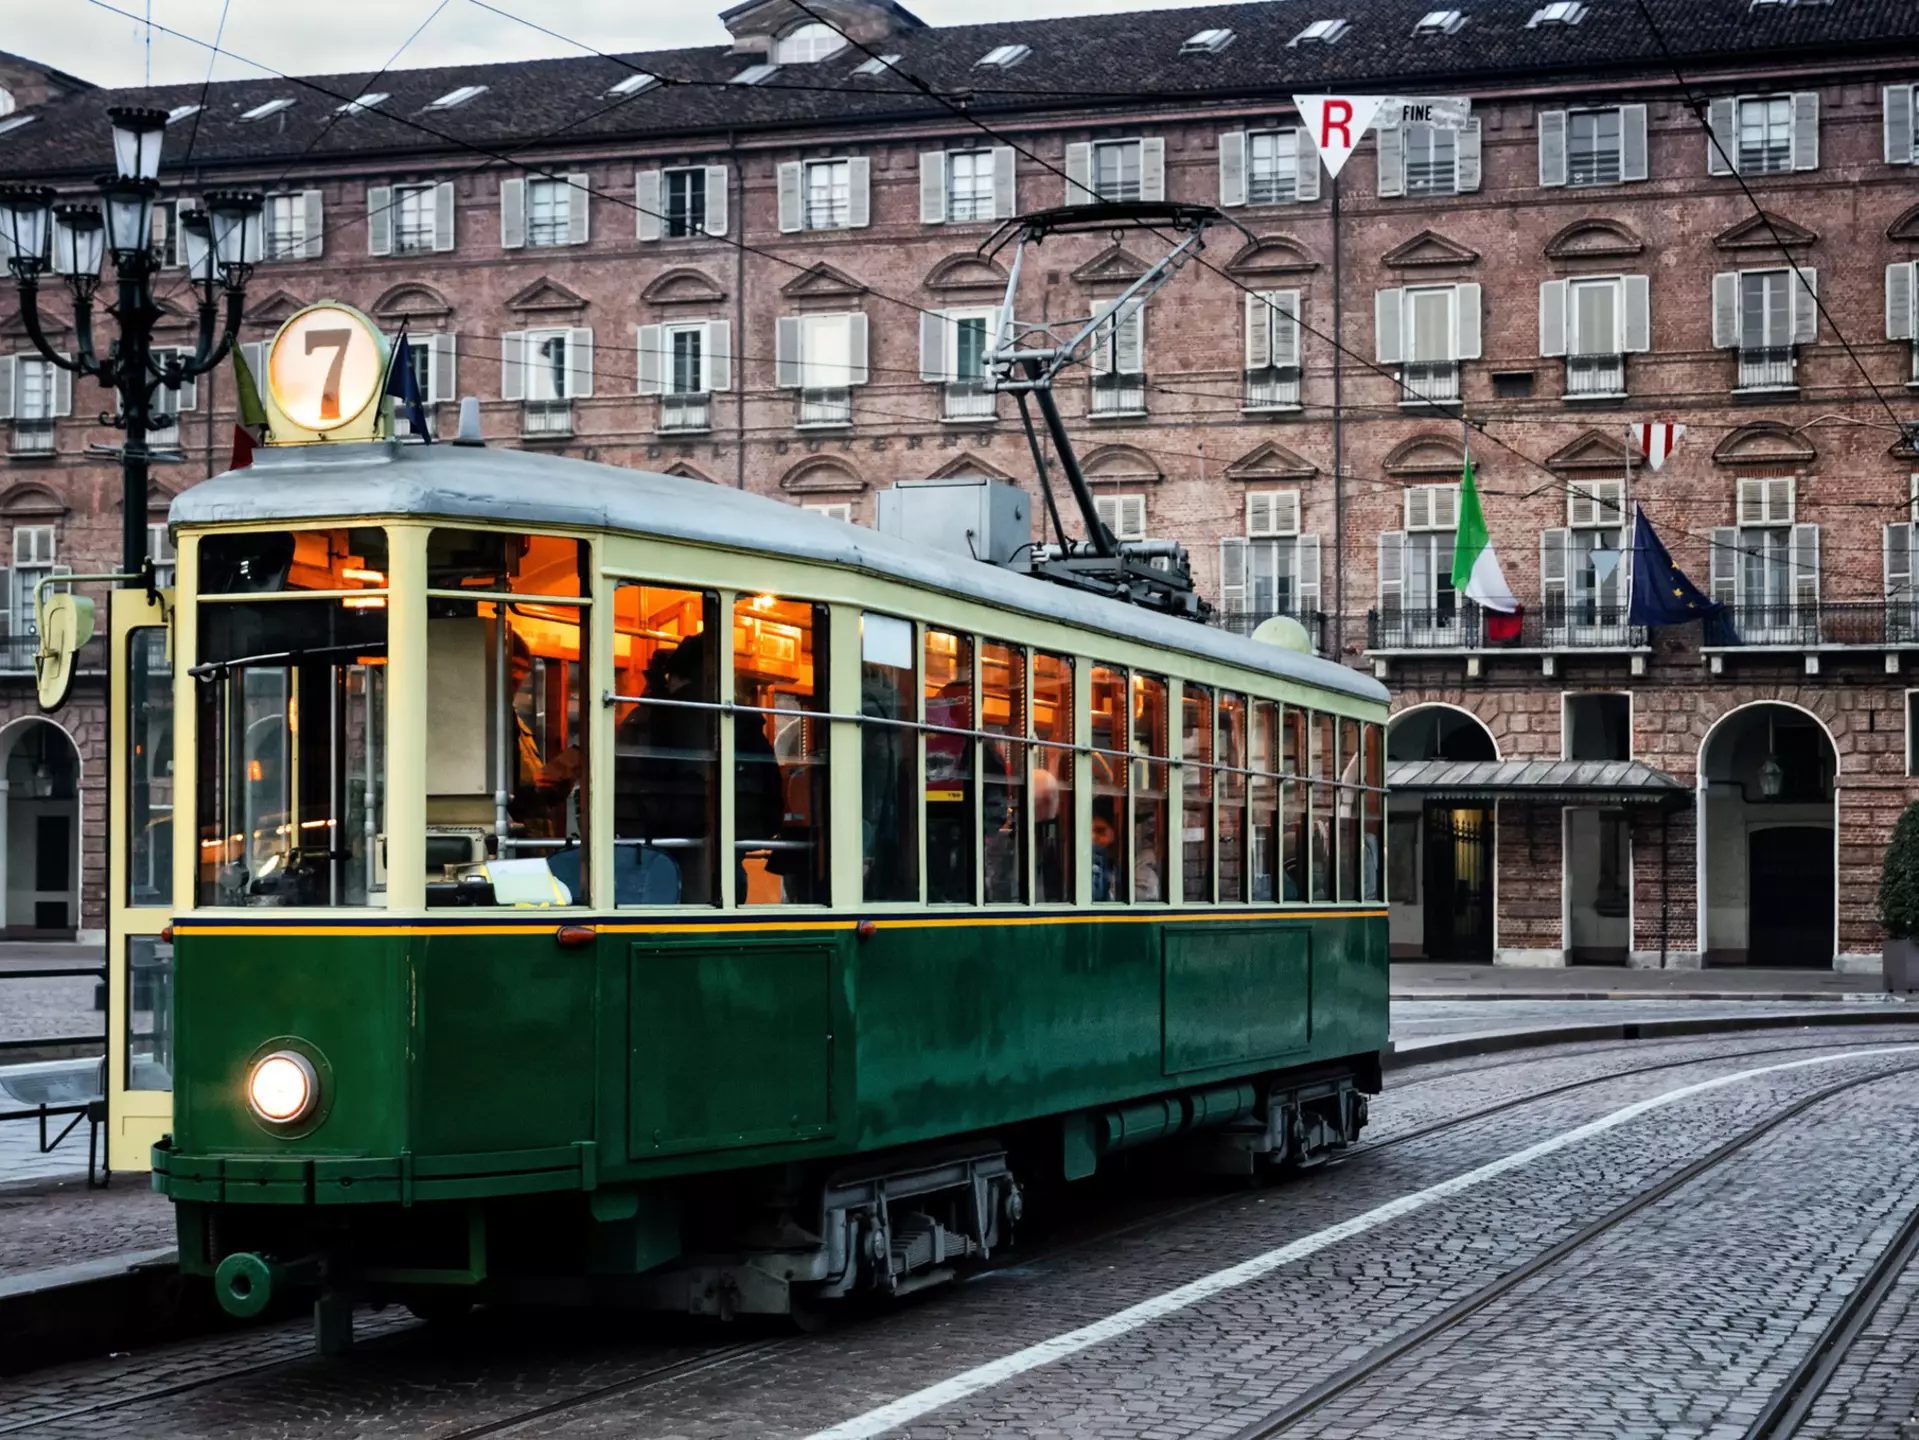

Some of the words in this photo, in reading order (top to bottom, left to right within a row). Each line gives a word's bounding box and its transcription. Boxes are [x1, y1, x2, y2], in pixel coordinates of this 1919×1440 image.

[1321, 99, 1353, 148] R
[1402, 105, 1432, 121] FINE
[304, 328, 352, 420] 7
